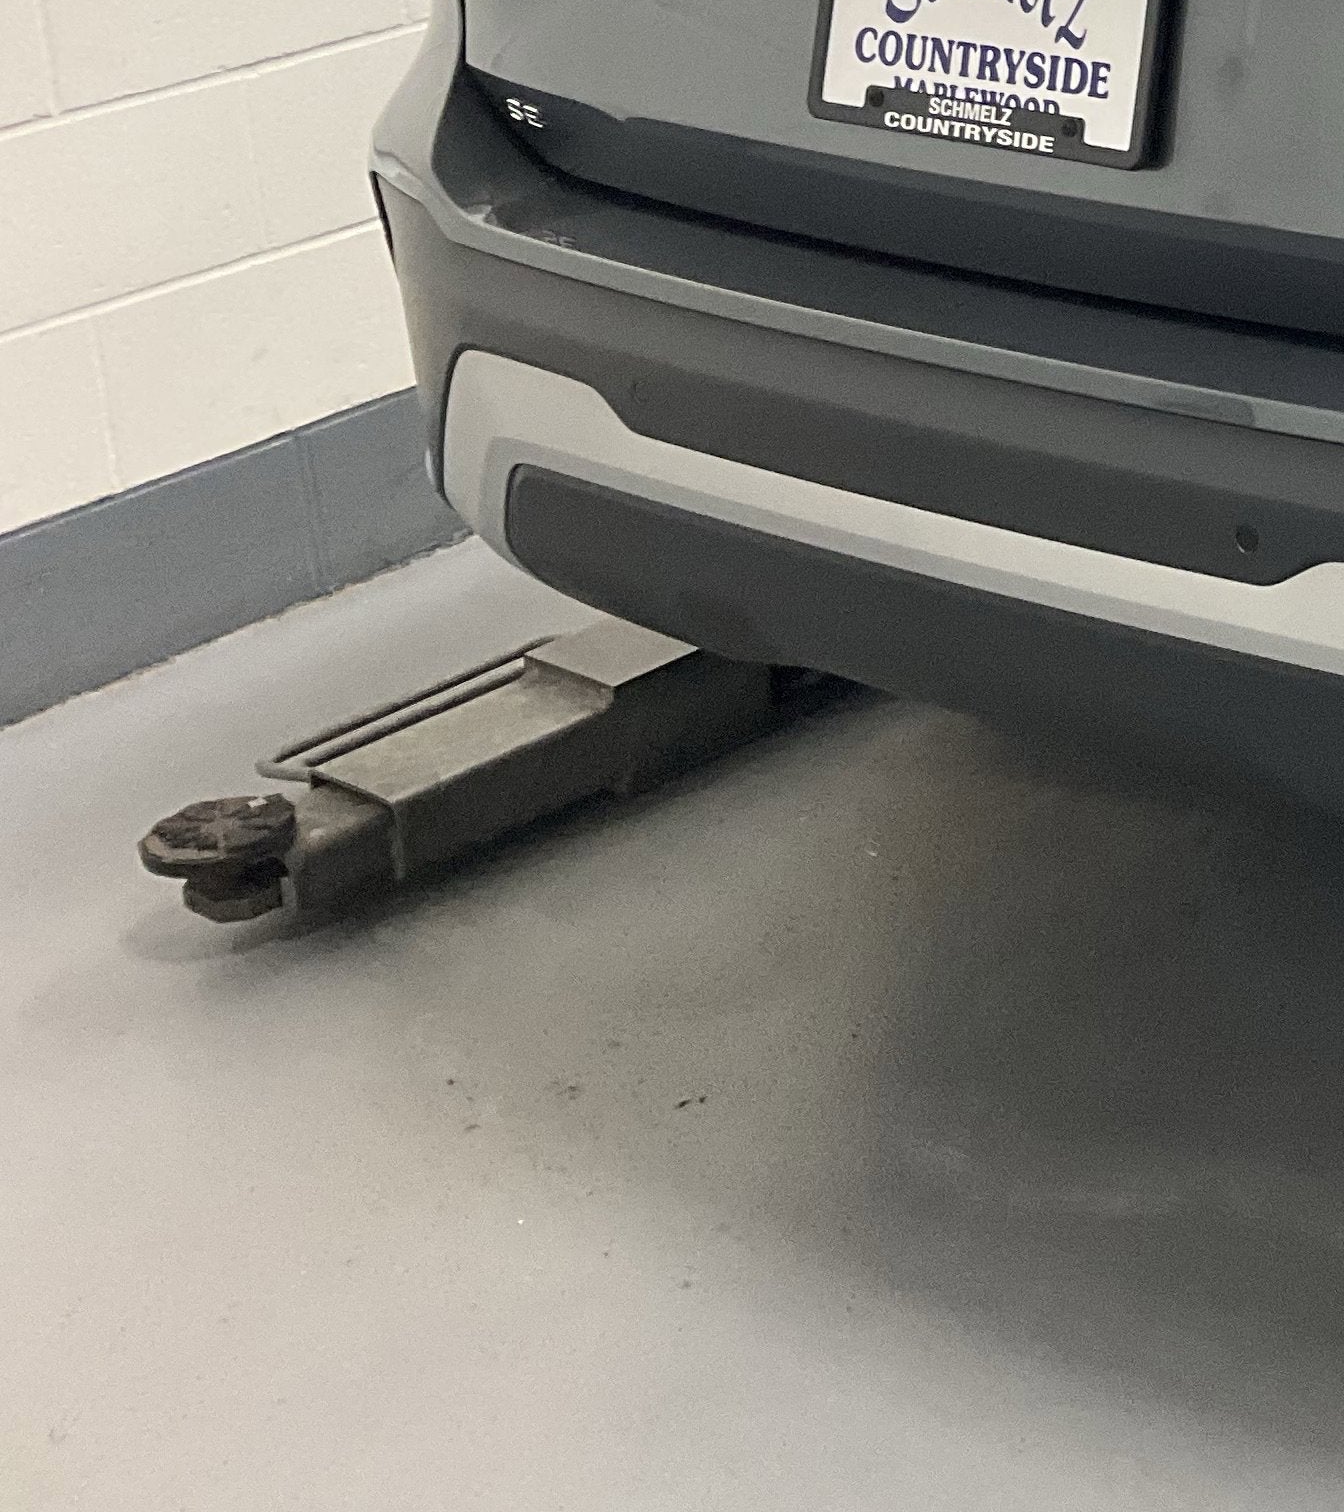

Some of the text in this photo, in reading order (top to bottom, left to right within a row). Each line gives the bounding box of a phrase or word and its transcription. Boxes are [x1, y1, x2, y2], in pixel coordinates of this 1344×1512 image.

[854, 26, 1112, 100] COUNTRYSIDE
[505, 97, 545, 129] SE
[928, 96, 1014, 127] SCHMELZ
[883, 111, 1056, 154] COUNTRYSIDE
